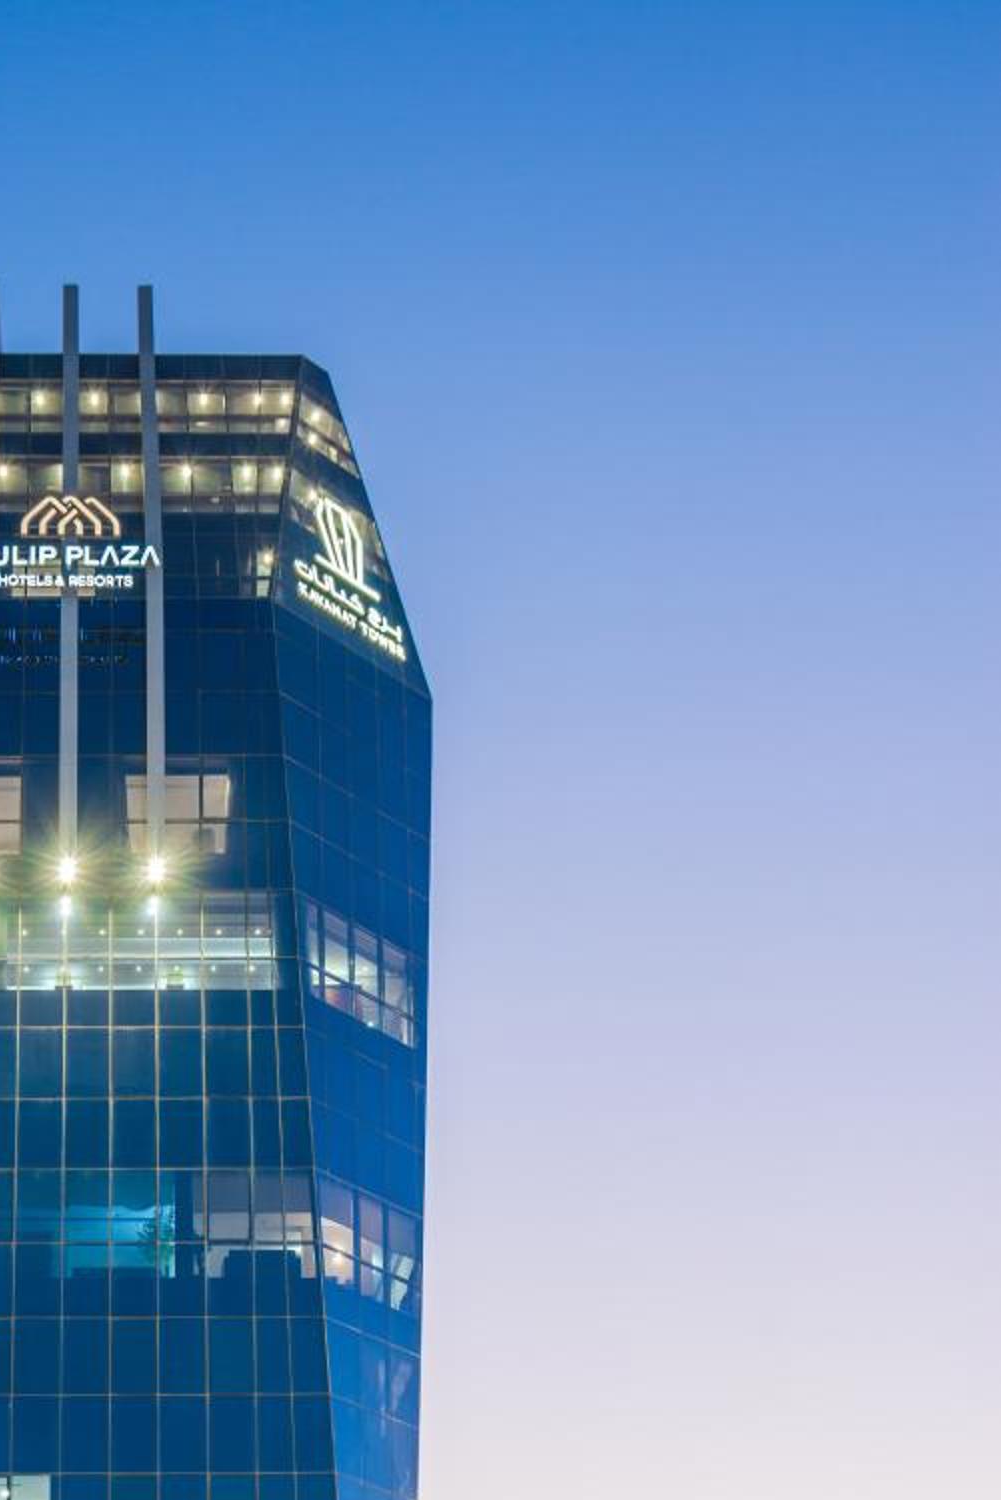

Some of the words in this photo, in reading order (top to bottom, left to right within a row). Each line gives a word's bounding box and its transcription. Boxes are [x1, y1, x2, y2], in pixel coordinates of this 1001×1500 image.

[65, 545, 161, 567] PLAZA
[53, 575, 65, 587] &
[68, 574, 135, 588] RESORTS
